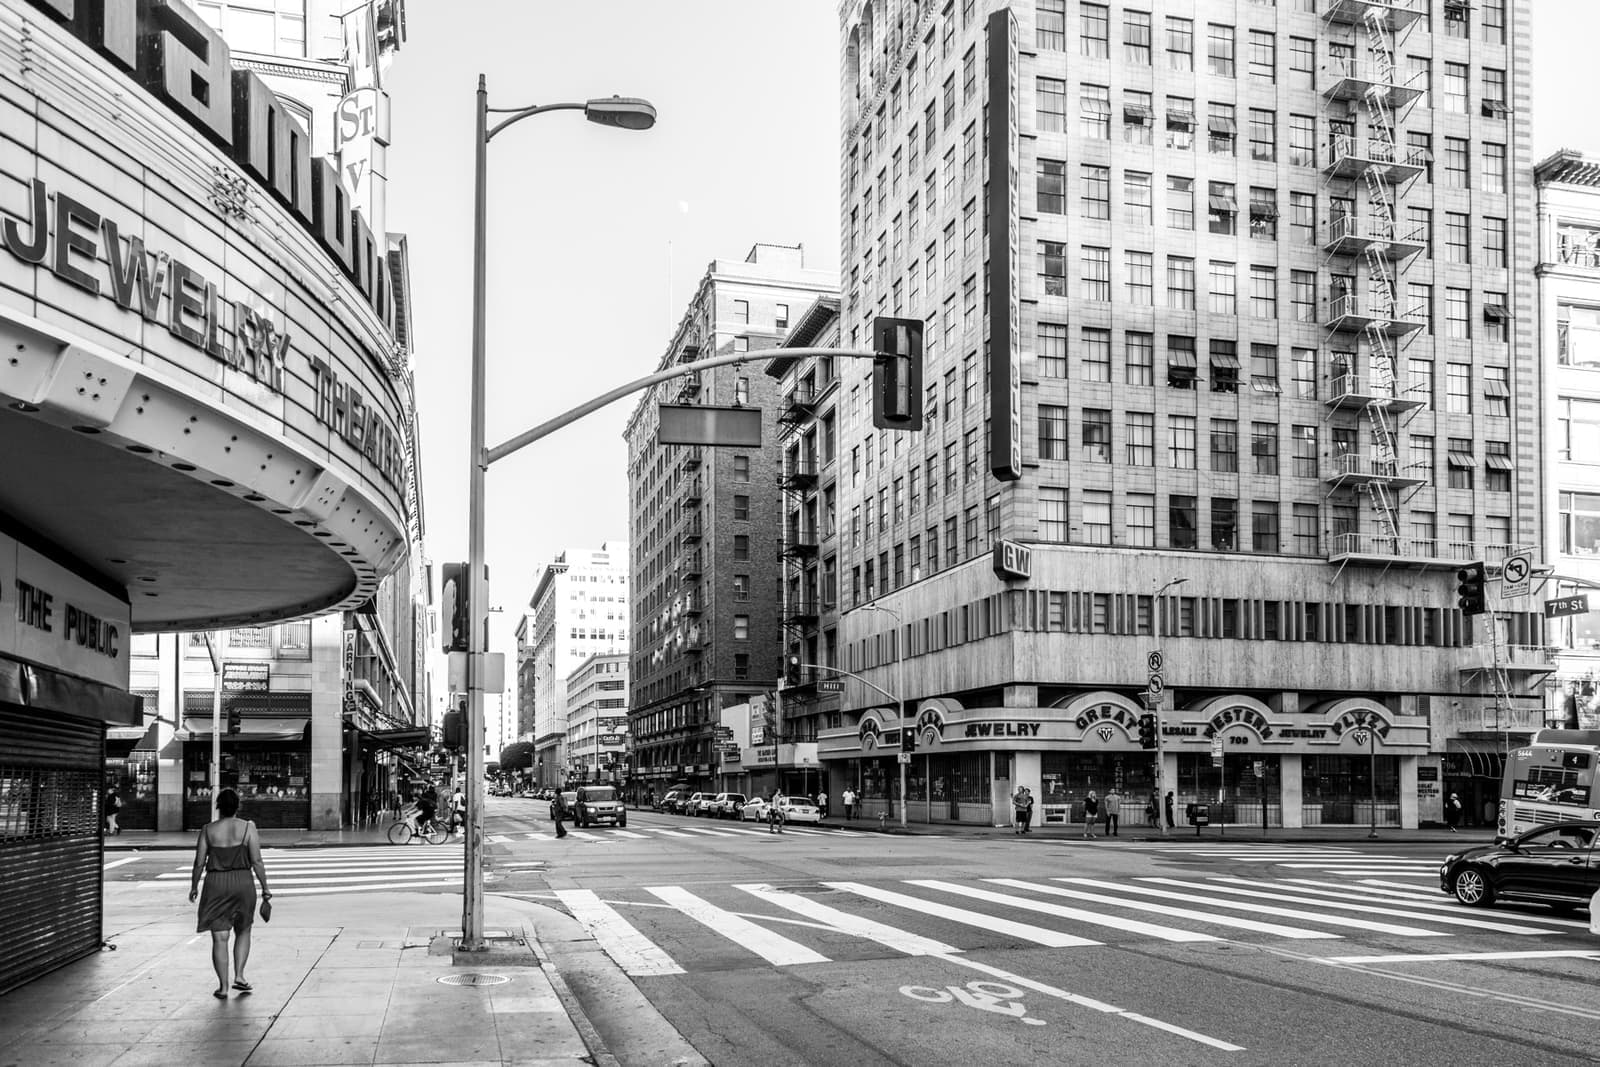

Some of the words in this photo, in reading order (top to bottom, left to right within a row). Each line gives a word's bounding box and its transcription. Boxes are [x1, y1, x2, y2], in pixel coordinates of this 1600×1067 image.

[1010, 162, 1019, 355] WESTERN
[1, 177, 291, 394] JEWELRY
[1005, 545, 1030, 574] GW
[15, 579, 54, 632] THE
[64, 603, 119, 658] PUBLIC
[1549, 602, 1567, 615] 7th
[1570, 600, 1584, 611] St
[346, 632, 354, 701] PARKING
[965, 723, 1041, 738] JEWELRY
[1075, 705, 1138, 730] GREAT
[1203, 709, 1273, 740] WESTERN
[1229, 736, 1249, 745] 700
[1279, 729, 1327, 739] JEWELRY
[1572, 756, 1578, 764] 4
